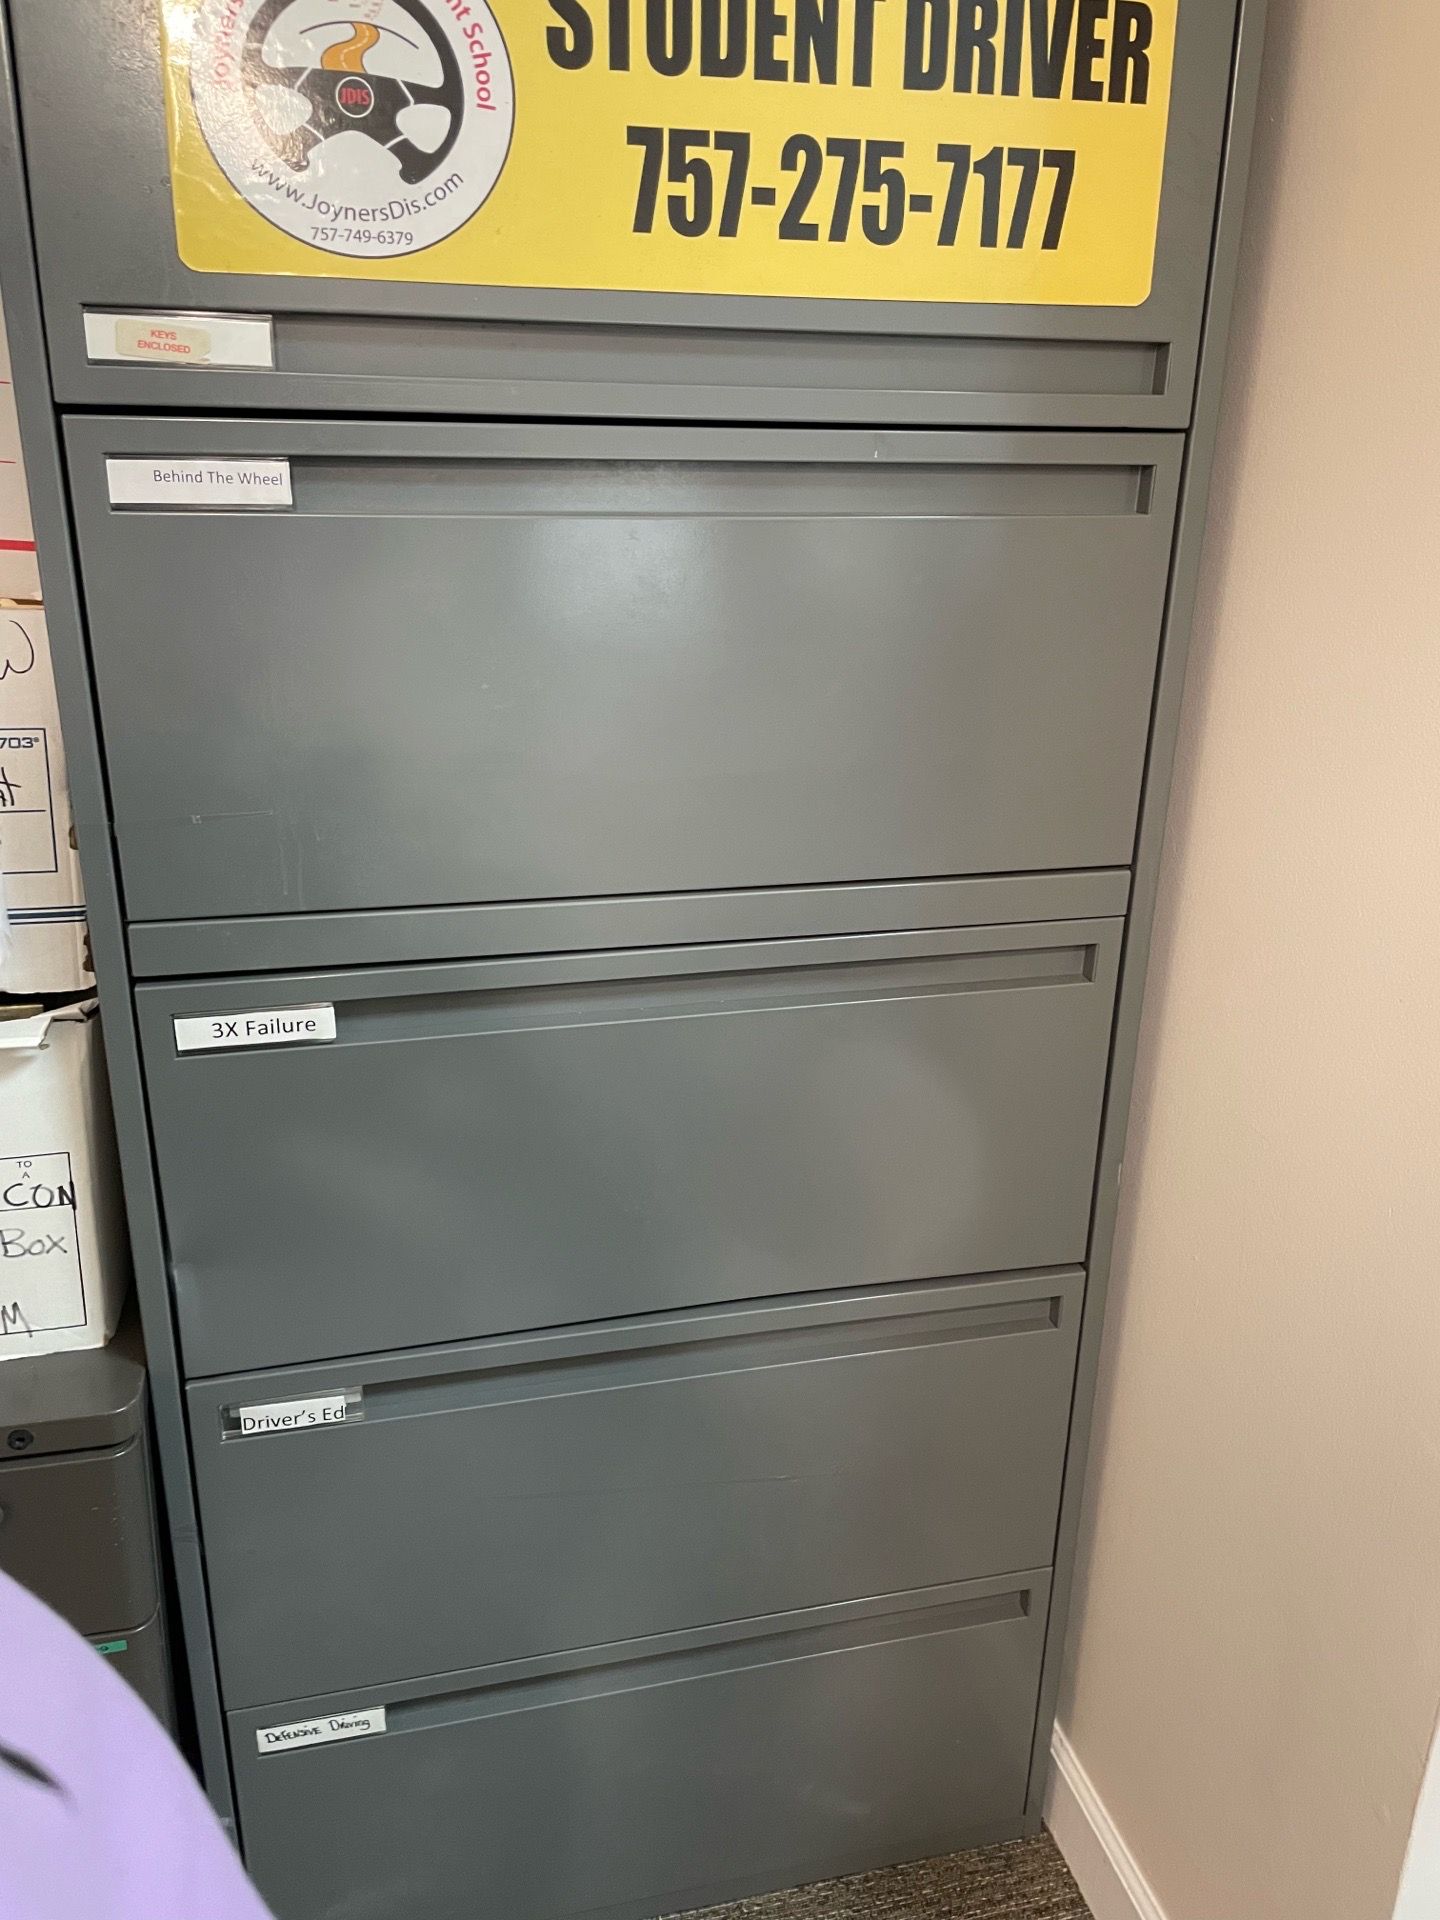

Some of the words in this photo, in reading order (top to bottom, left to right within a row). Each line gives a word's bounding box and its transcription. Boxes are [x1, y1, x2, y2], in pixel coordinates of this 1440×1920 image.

[546, 0, 887, 87] STUDENT
[903, 0, 1155, 105] DRIVER
[462, 22, 497, 111] School
[250, 158, 465, 222] www.JoynersDis.com
[626, 125, 1076, 251] 757-275-7177
[310, 226, 414, 246] 757-749-6379
[137, 339, 191, 354] ENCLOSED
[150, 329, 177, 341] KEYS
[153, 469, 203, 483] Behind
[207, 471, 233, 484] The
[238, 472, 283, 486] Wheel
[211, 1021, 239, 1039] 3X
[246, 1018, 317, 1036] Failure
[243, 1410, 317, 1431] Driver's
[322, 1405, 345, 1421] Ed
